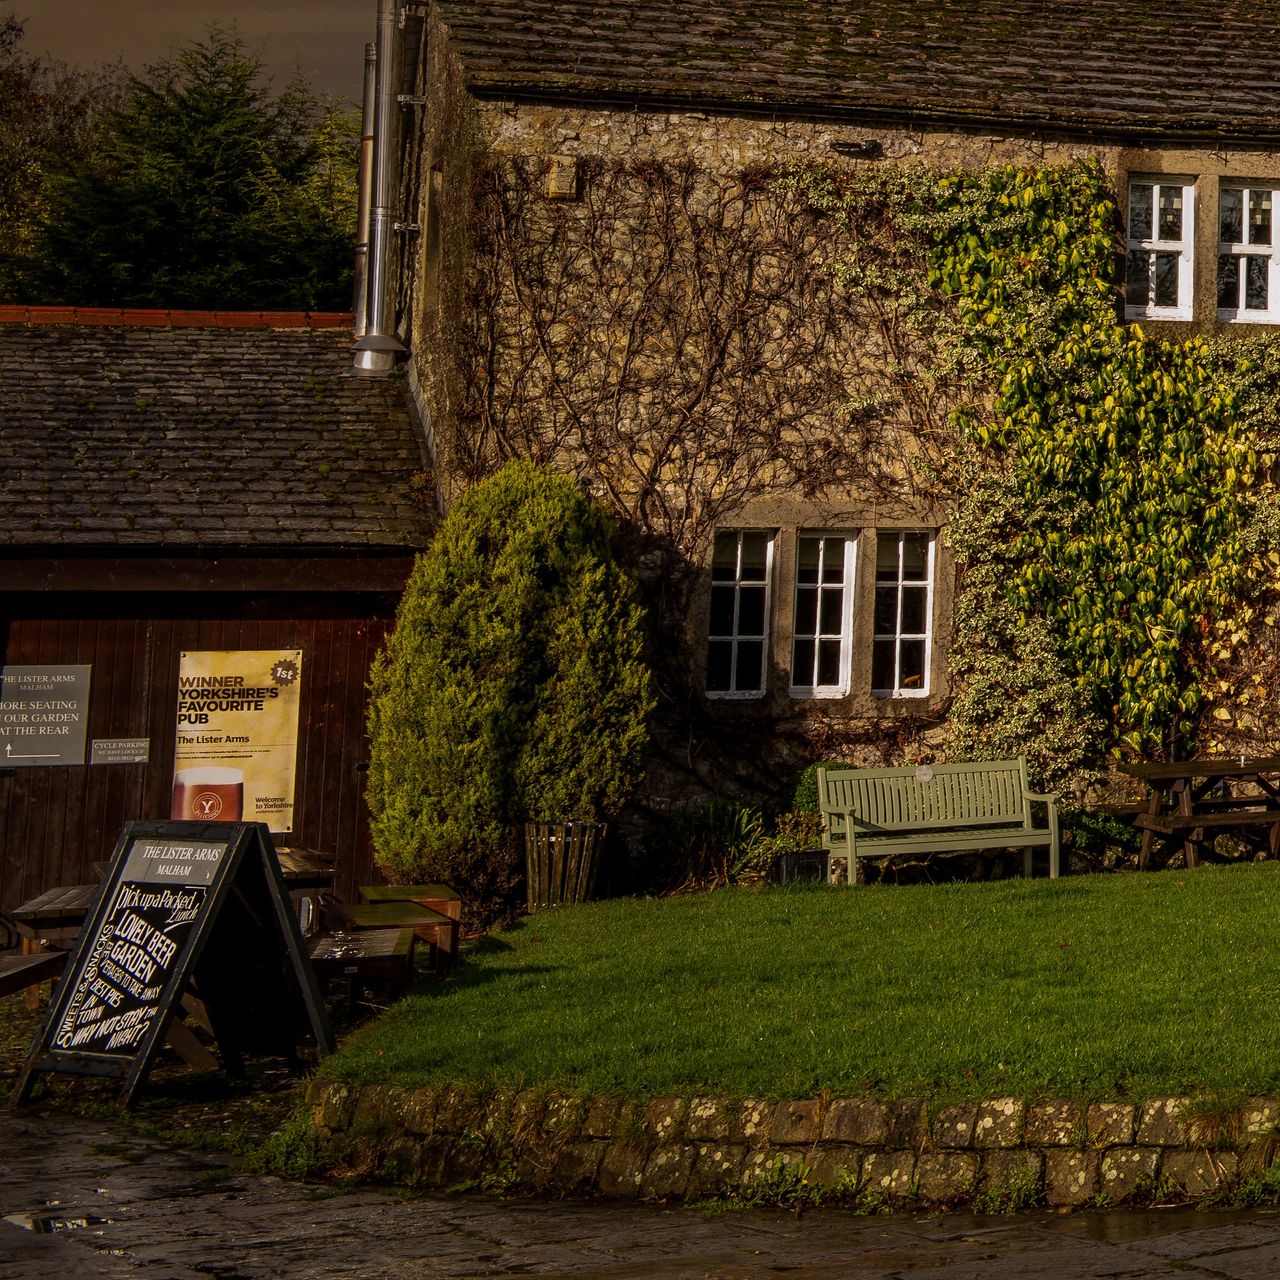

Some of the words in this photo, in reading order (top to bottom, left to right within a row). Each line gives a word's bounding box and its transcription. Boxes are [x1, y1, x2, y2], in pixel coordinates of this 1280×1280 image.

[18, 675, 48, 683] LISTER
[51, 675, 76, 683] ARMS
[276, 667, 294, 680] 1st
[179, 676, 244, 688] WINNER
[179, 687, 279, 700] YORKSHIRE'S
[29, 700, 77, 710] SEATING
[178, 700, 264, 712] FAVOURITE
[4, 713, 29, 723] OUR
[31, 713, 80, 723] GARDEN
[177, 713, 209, 725] PUB
[13, 726, 37, 736] THE
[39, 726, 70, 735] REAR
[177, 736, 194, 744] The
[196, 735, 224, 743] Lister
[225, 735, 250, 743] Arms
[142, 845, 161, 858] THE
[161, 846, 193, 860] LISTER
[193, 848, 221, 861] ARMS
[156, 865, 192, 876] MALHAM
[159, 889, 198, 910] Packed
[114, 910, 154, 945] LOVELY
[146, 931, 177, 969] BEER
[111, 940, 157, 983] GARDEN
[56, 991, 84, 1048] SWEETS
[84, 924, 114, 982] SNACKS
[90, 978, 112, 998] BEST
[104, 987, 124, 1008] PIES
[120, 972, 132, 989] TO
[128, 976, 145, 998] TAKE
[140, 984, 163, 1000] AWAY
[81, 994, 99, 1011] IN
[77, 1005, 106, 1025] TOWN
[71, 1022, 101, 1047] WHY
[94, 1016, 122, 1039] NOT
[115, 1006, 149, 1031] STAY
[105, 1021, 151, 1051] NIGHT?
